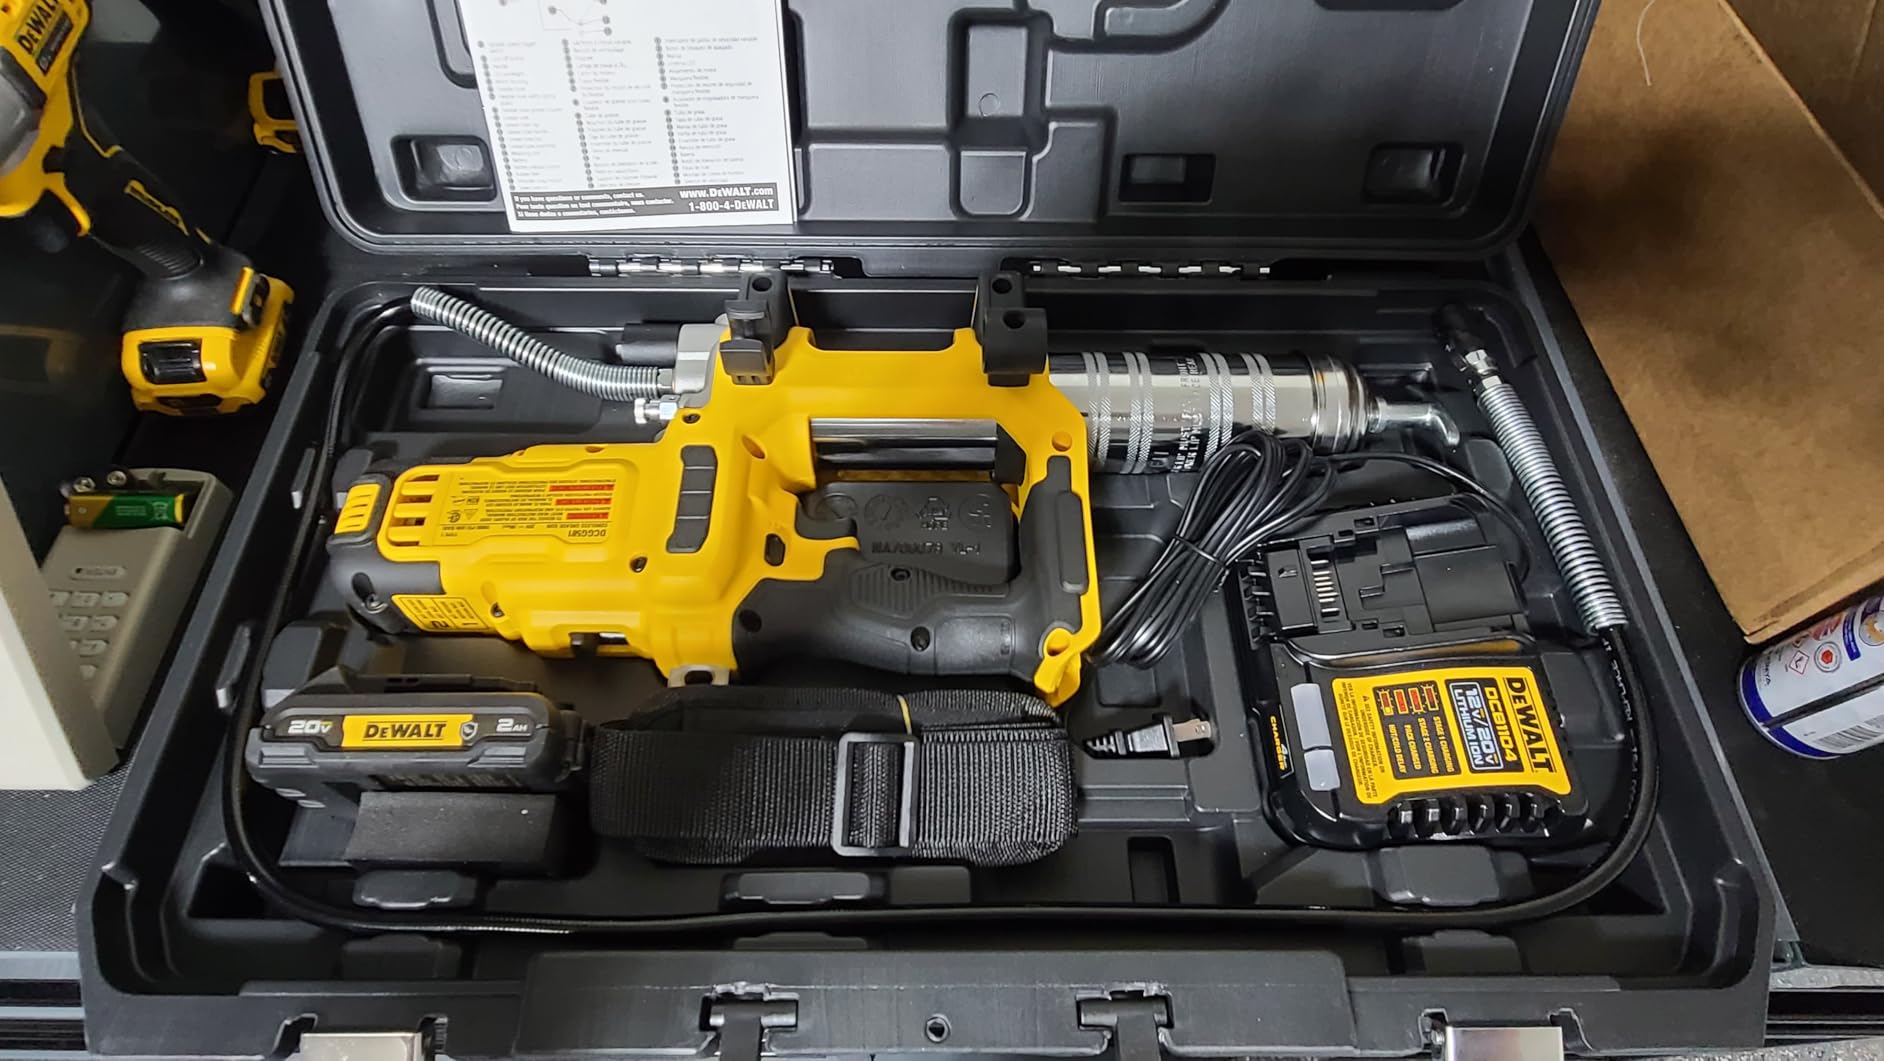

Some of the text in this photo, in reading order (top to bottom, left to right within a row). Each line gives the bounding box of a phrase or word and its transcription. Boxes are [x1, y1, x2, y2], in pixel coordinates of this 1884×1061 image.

[17, 0, 60, 55] DEWAL
[679, 187, 773, 199] www.DEWALT.com
[1178, 425, 1191, 451] MUST
[362, 722, 447, 739] DEWALT
[1270, 716, 1285, 770] CHARGER
[1388, 724, 1408, 774] HOT/COLD DELAY
[1404, 724, 1422, 770] PACK CHARGED
[1418, 717, 1430, 737] STAGE
[1425, 741, 1439, 774] CHARGING
[1433, 716, 1445, 736] STAGE
[1439, 740, 1455, 773] CHARGING
[1453, 689, 1485, 764] LITHIUM ION
[1484, 686, 1518, 762] DCB1104
[1505, 677, 1553, 773] DEWALT
